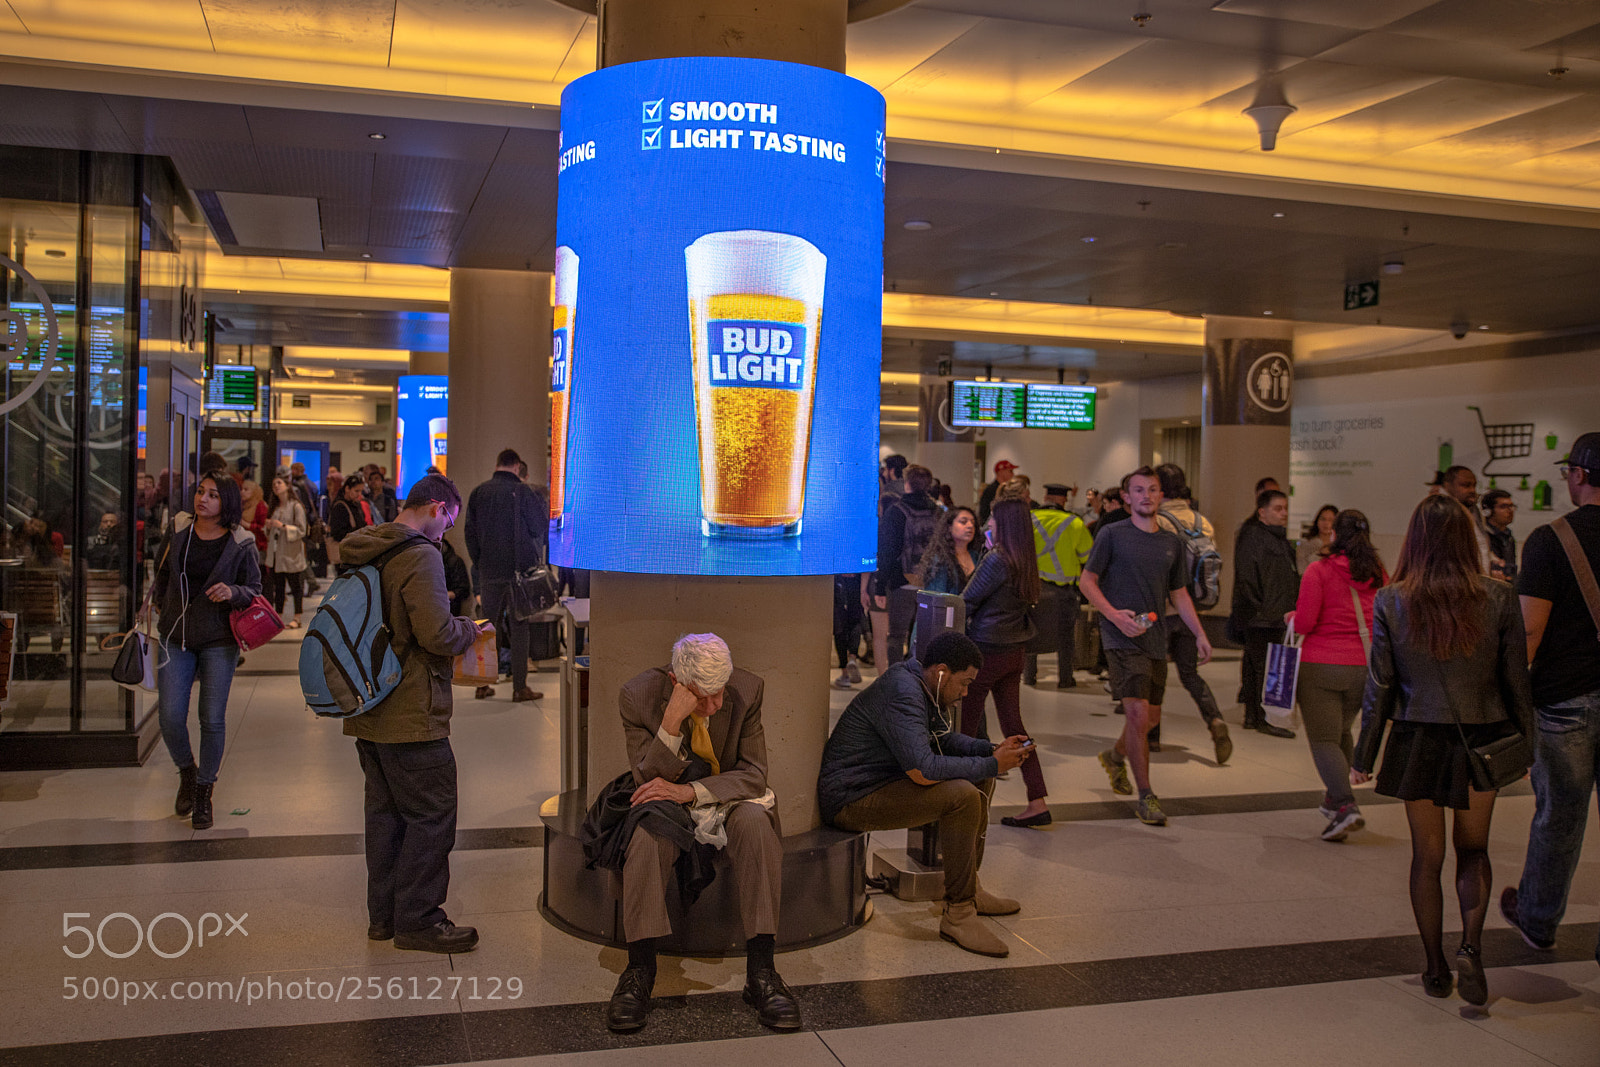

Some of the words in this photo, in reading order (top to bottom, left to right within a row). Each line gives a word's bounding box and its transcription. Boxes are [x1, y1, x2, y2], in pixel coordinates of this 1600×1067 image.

[669, 102, 777, 125] SMOOTH
[558, 140, 596, 176] ASTING
[670, 129, 743, 150] LIGHT
[750, 131, 846, 163] TASTING
[722, 327, 793, 357] BUD
[711, 353, 803, 383] LIGHT
[1333, 417, 1384, 434] groceries
[362, 441, 370, 451] 3
